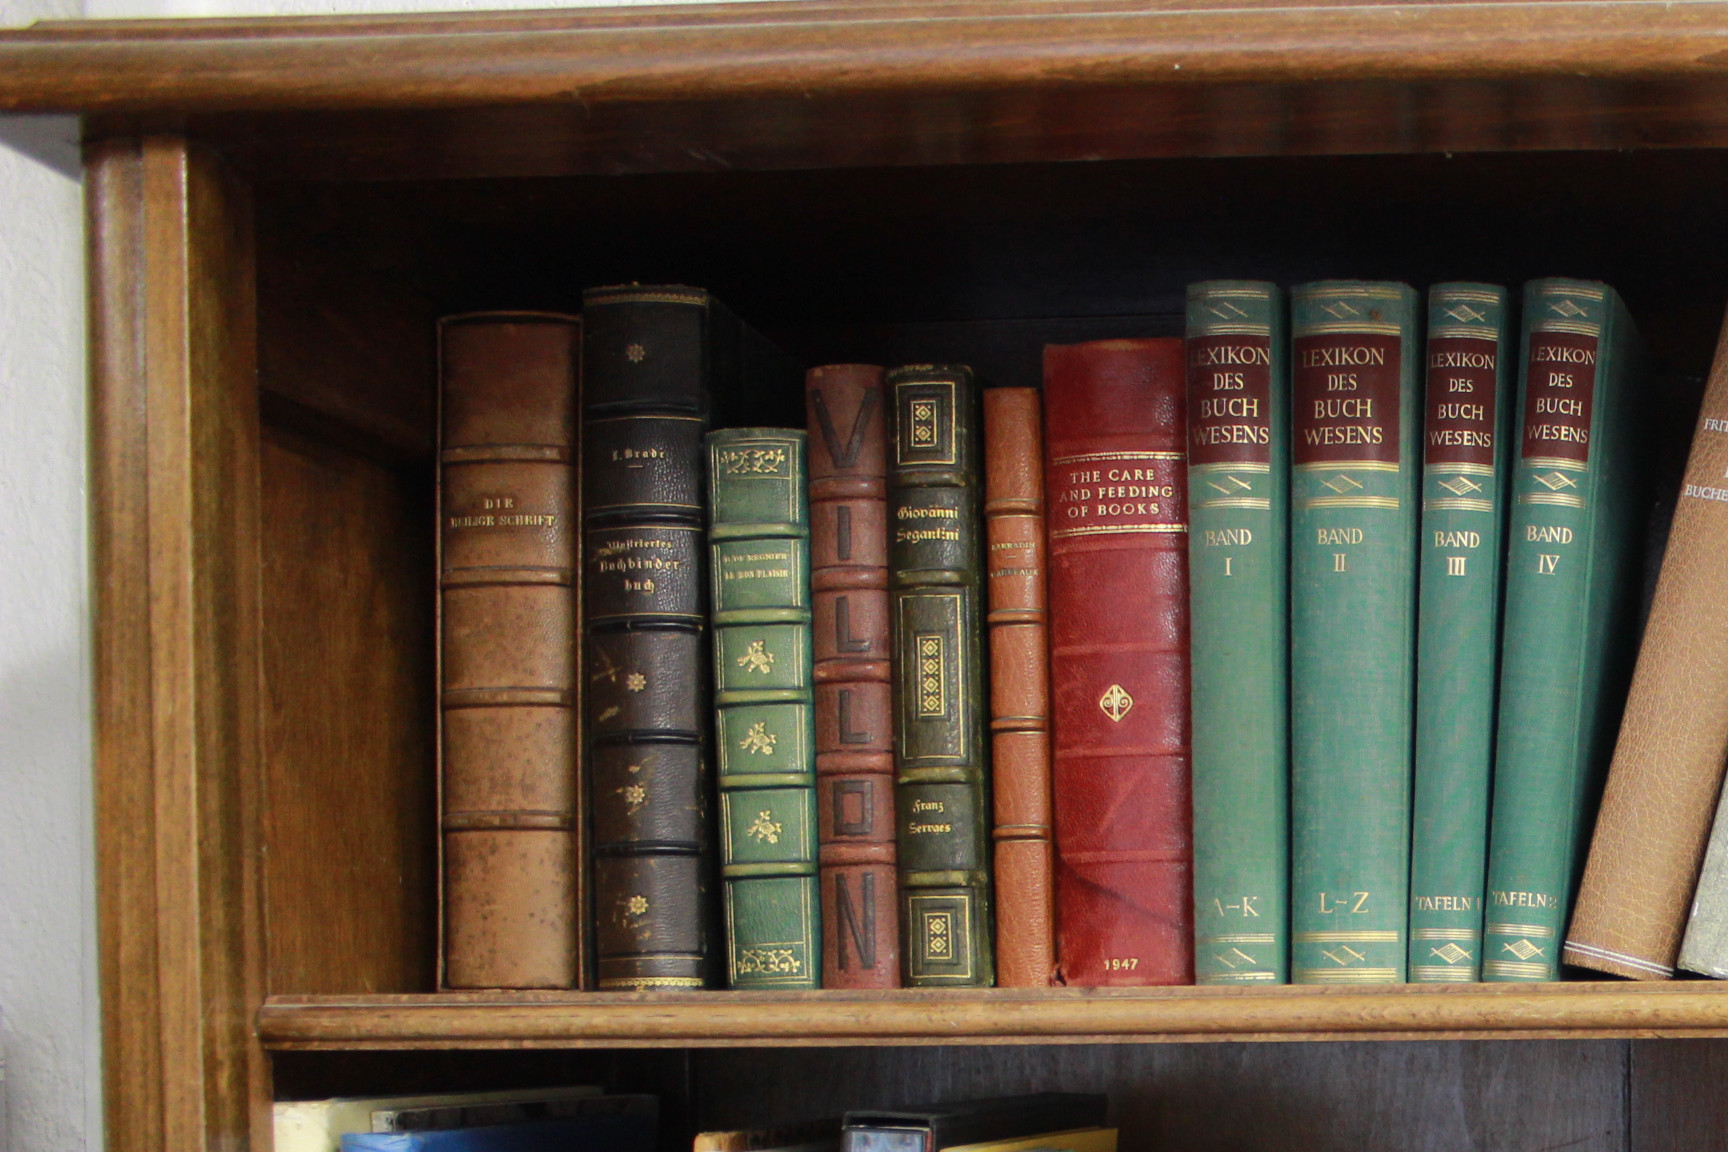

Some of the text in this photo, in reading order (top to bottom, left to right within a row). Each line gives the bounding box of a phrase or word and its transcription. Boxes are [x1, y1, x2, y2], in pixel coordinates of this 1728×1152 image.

[1302, 347, 1385, 367] LEXIKON
[1430, 351, 1496, 371] LEXIKON
[1530, 346, 1596, 366] LEXIKON
[1213, 373, 1244, 391] DES
[1327, 374, 1358, 391] DES
[1449, 378, 1474, 393] DES
[1549, 372, 1573, 388] DES
[1201, 398, 1259, 418] BUCH
[1314, 399, 1373, 418] BUCH
[1438, 403, 1484, 421] BUCH
[1536, 398, 1583, 416] BUCH
[1194, 425, 1270, 444] WESENS
[1304, 426, 1383, 445] WESENS
[1429, 430, 1491, 448] WESENS
[1527, 424, 1588, 444] WESENS
[1070, 468, 1155, 484] THE CARE
[1060, 485, 1173, 503] AND FEEDING
[897, 504, 959, 520] Giovanni
[1067, 503, 1160, 519] OF BOOKS
[896, 528, 960, 545] Segantini
[1205, 528, 1252, 546] BAND
[1317, 527, 1364, 545] BAND
[1434, 530, 1480, 549] BAND
[1525, 525, 1573, 545] BAND
[1223, 557, 1233, 576] I
[1333, 553, 1347, 572] II
[1447, 557, 1466, 576] III
[1538, 554, 1560, 575] IV
[1415, 896, 1472, 912] TAFELN
[1492, 891, 1548, 909] TAFELN
[1103, 957, 1139, 972] 1947
